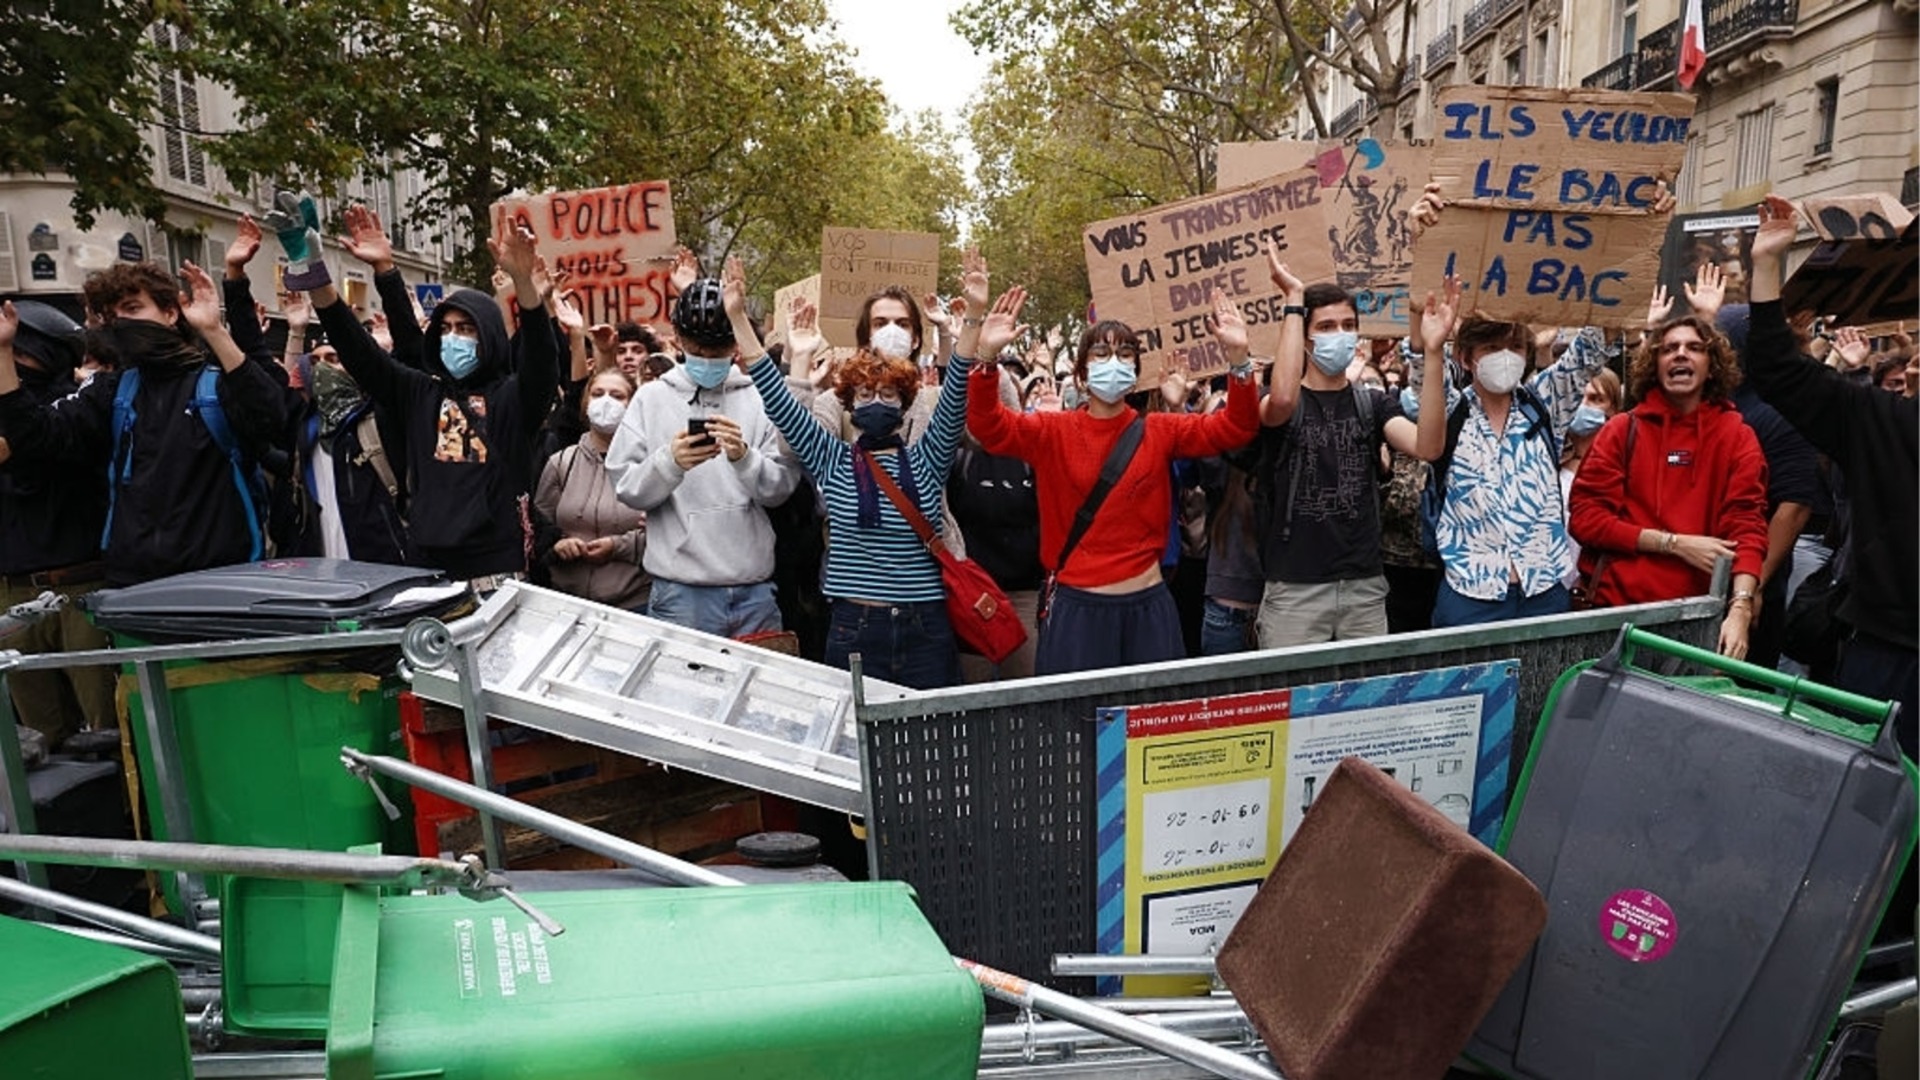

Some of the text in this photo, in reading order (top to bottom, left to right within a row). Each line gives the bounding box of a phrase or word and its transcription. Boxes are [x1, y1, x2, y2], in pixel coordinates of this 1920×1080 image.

[1444, 103, 1692, 143] ILS VEULENT
[1474, 159, 1658, 208] LE BAC
[551, 187, 662, 236] POLICE
[1088, 176, 1321, 256] VOUS TRANSFORMEZ
[828, 231, 866, 251] VOS
[1504, 210, 1593, 249] PAS
[556, 250, 627, 277] NOUS
[829, 256, 862, 273] ONT
[1122, 224, 1288, 288] LA JEUNESSE
[829, 280, 867, 296] POUR
[1526, 258, 1630, 306] BAC
[1129, 716, 1169, 728] PUBLIC
[1171, 714, 1185, 723] AU
[1188, 708, 1235, 721] INTERDIT
[1189, 924, 1216, 936] MDA
